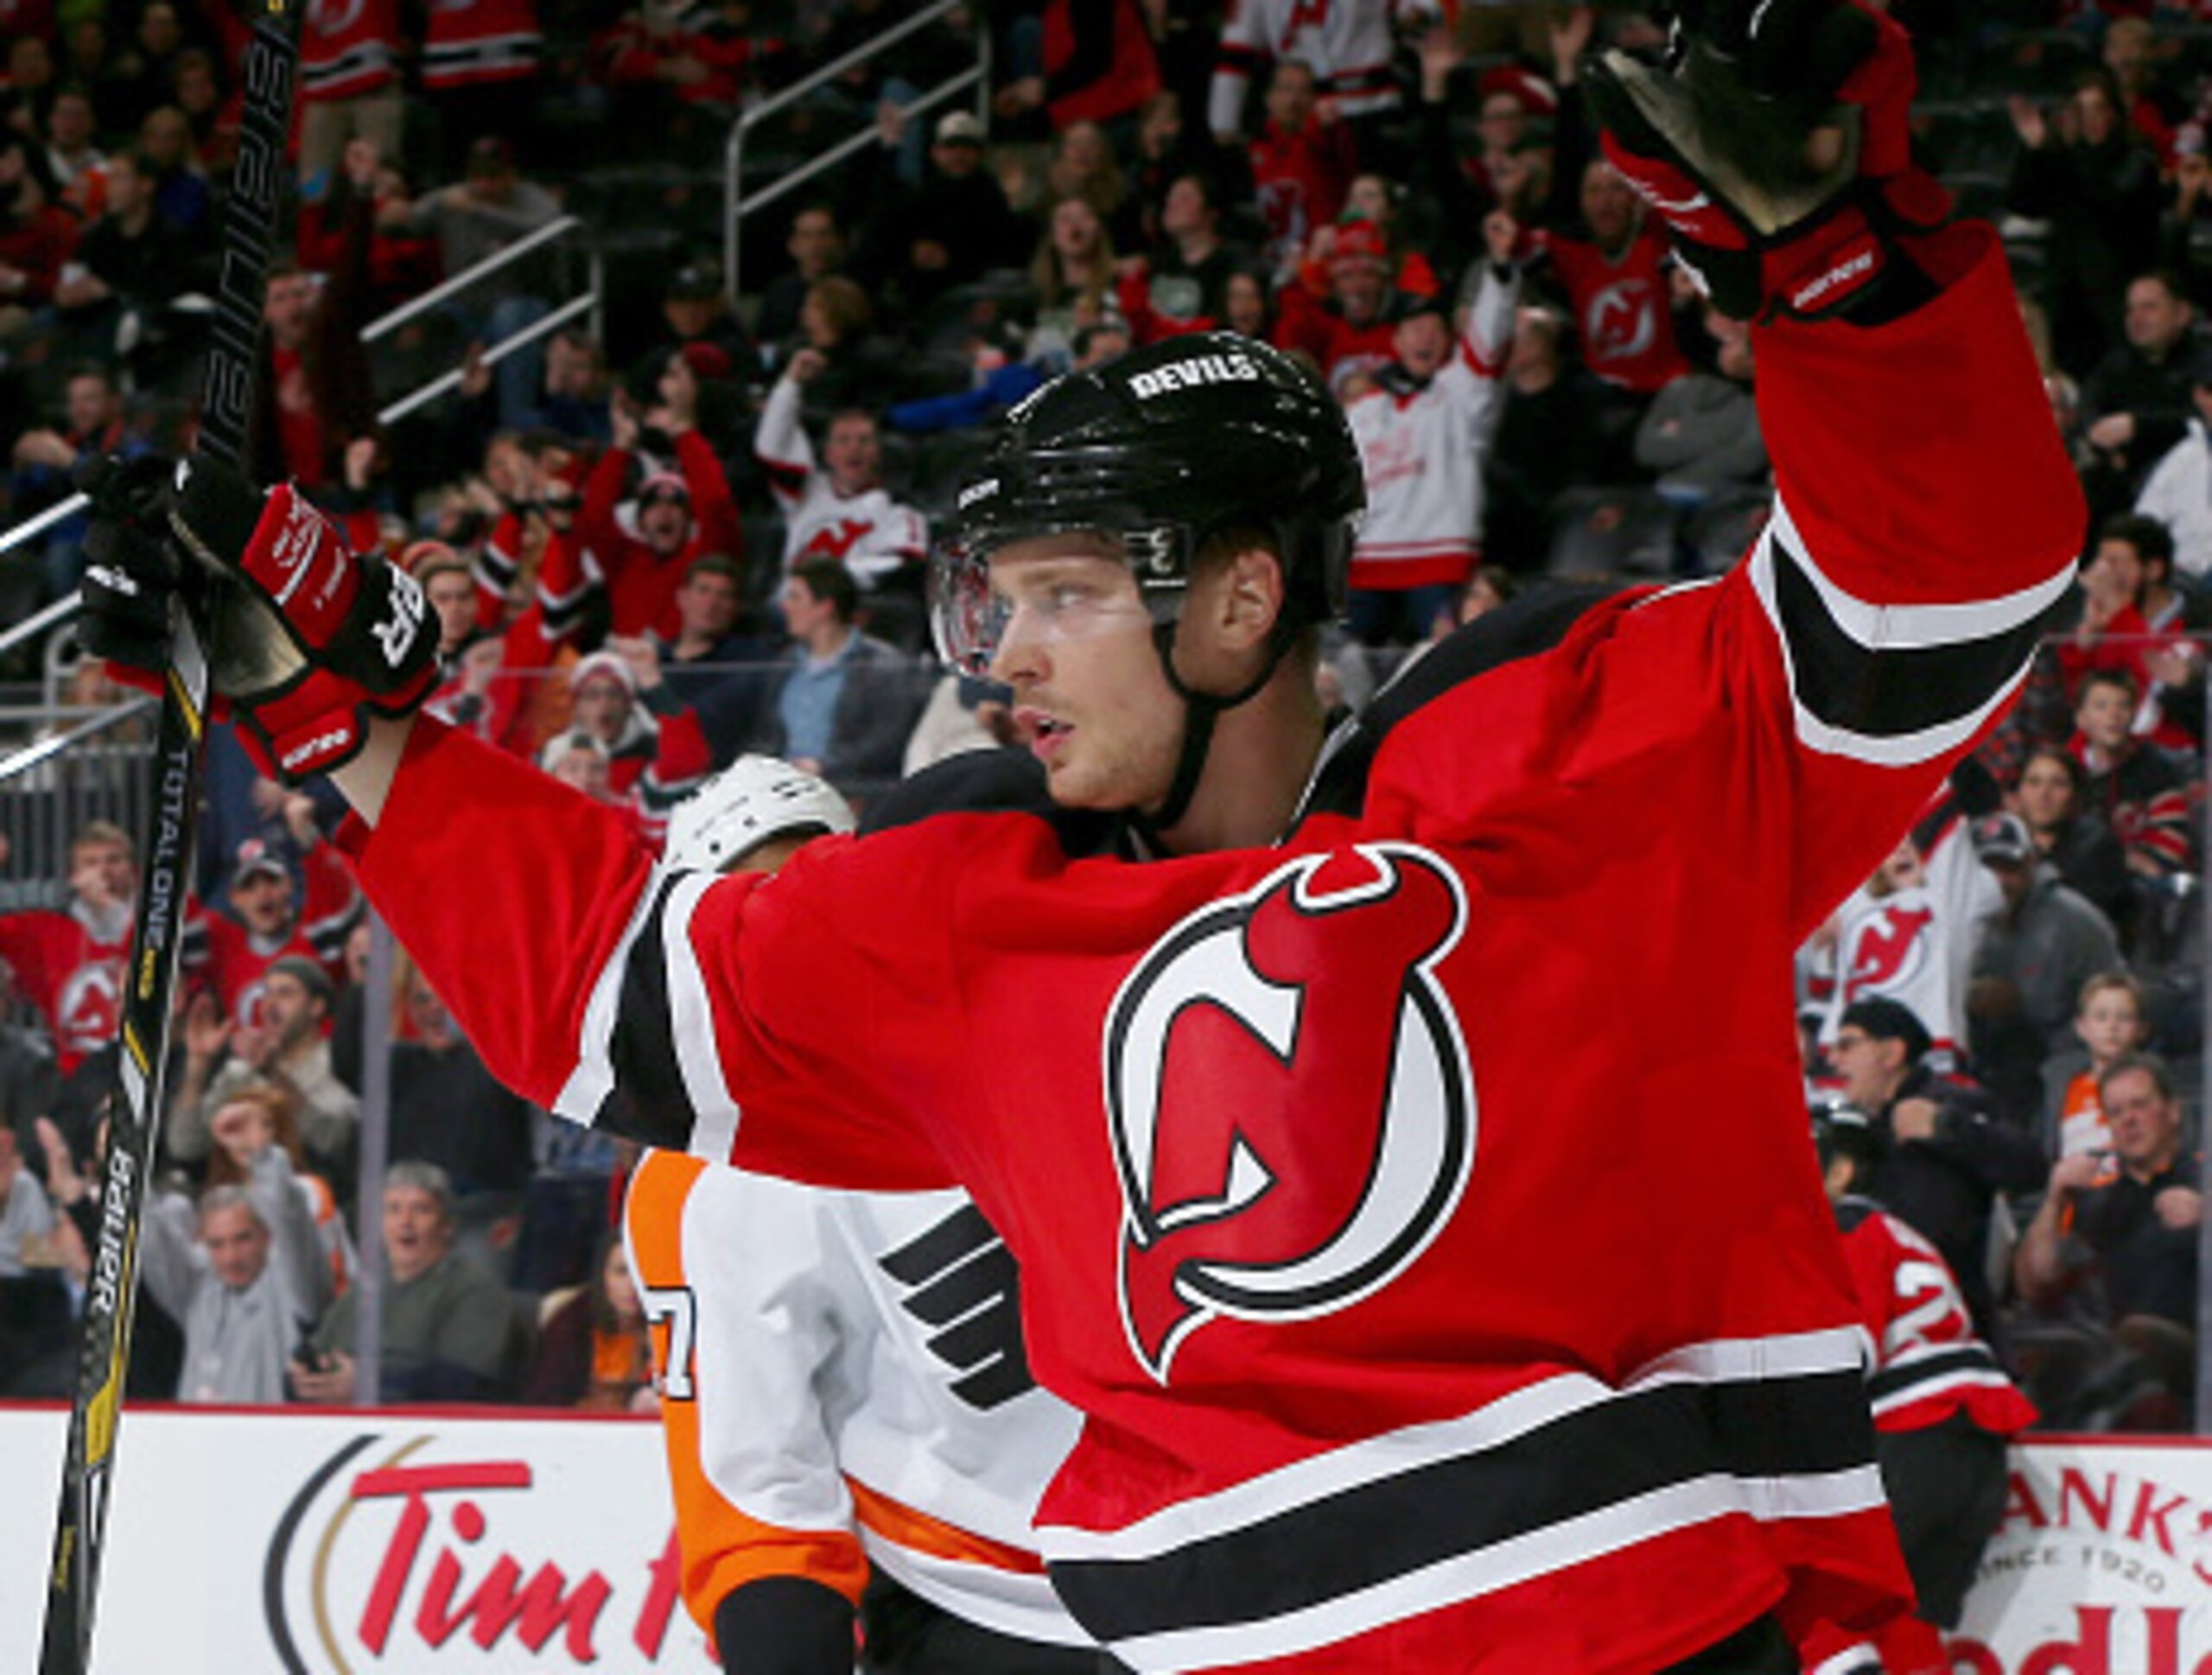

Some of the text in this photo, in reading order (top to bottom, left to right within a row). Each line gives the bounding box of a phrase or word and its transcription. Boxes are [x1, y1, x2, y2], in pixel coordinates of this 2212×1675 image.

[1127, 355, 1258, 399] DEVILS
[350, 1461, 613, 1662] Tim
[2081, 1545, 2166, 1594] 1920
